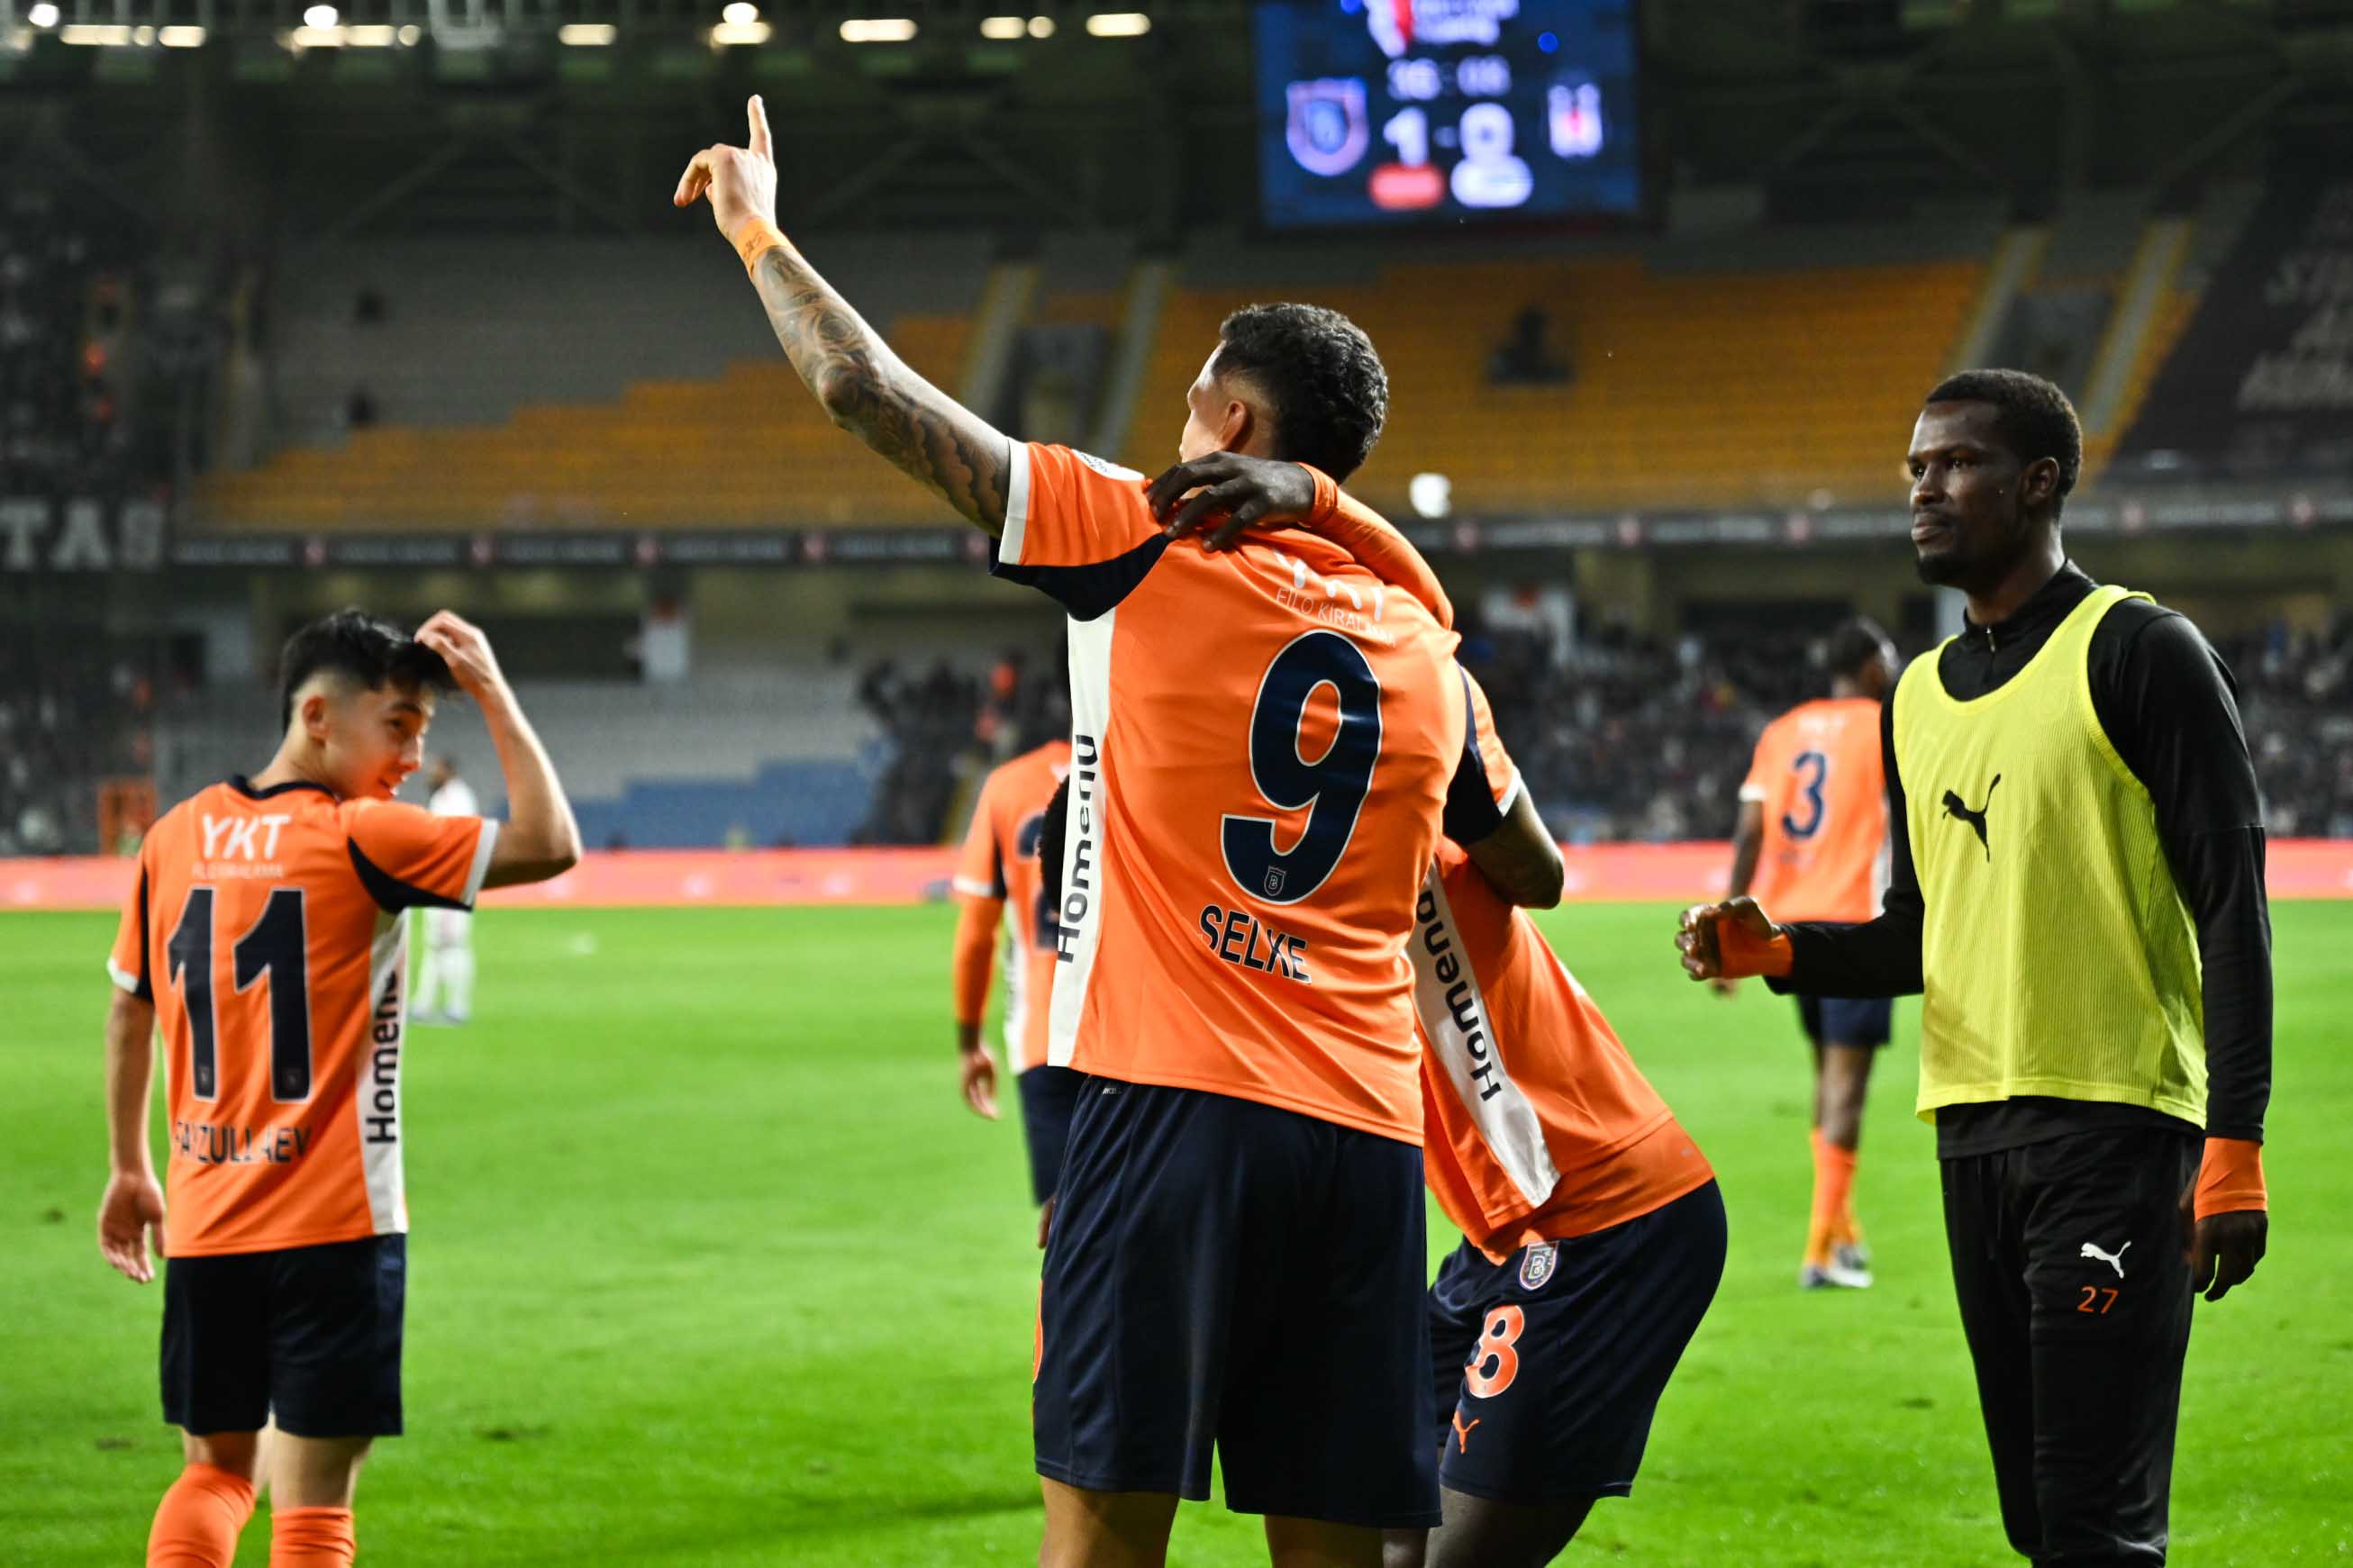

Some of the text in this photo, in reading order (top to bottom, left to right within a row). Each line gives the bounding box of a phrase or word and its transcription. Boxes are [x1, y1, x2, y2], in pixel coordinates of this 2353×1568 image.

[1221, 628, 1383, 905] 9
[1780, 748, 1829, 839] 3
[201, 813, 292, 860] YKT
[1199, 903, 1313, 983] SELKE
[167, 885, 314, 1103] 11
[2076, 1284, 2120, 1314] 27
[1465, 1304, 1525, 1399] 8
